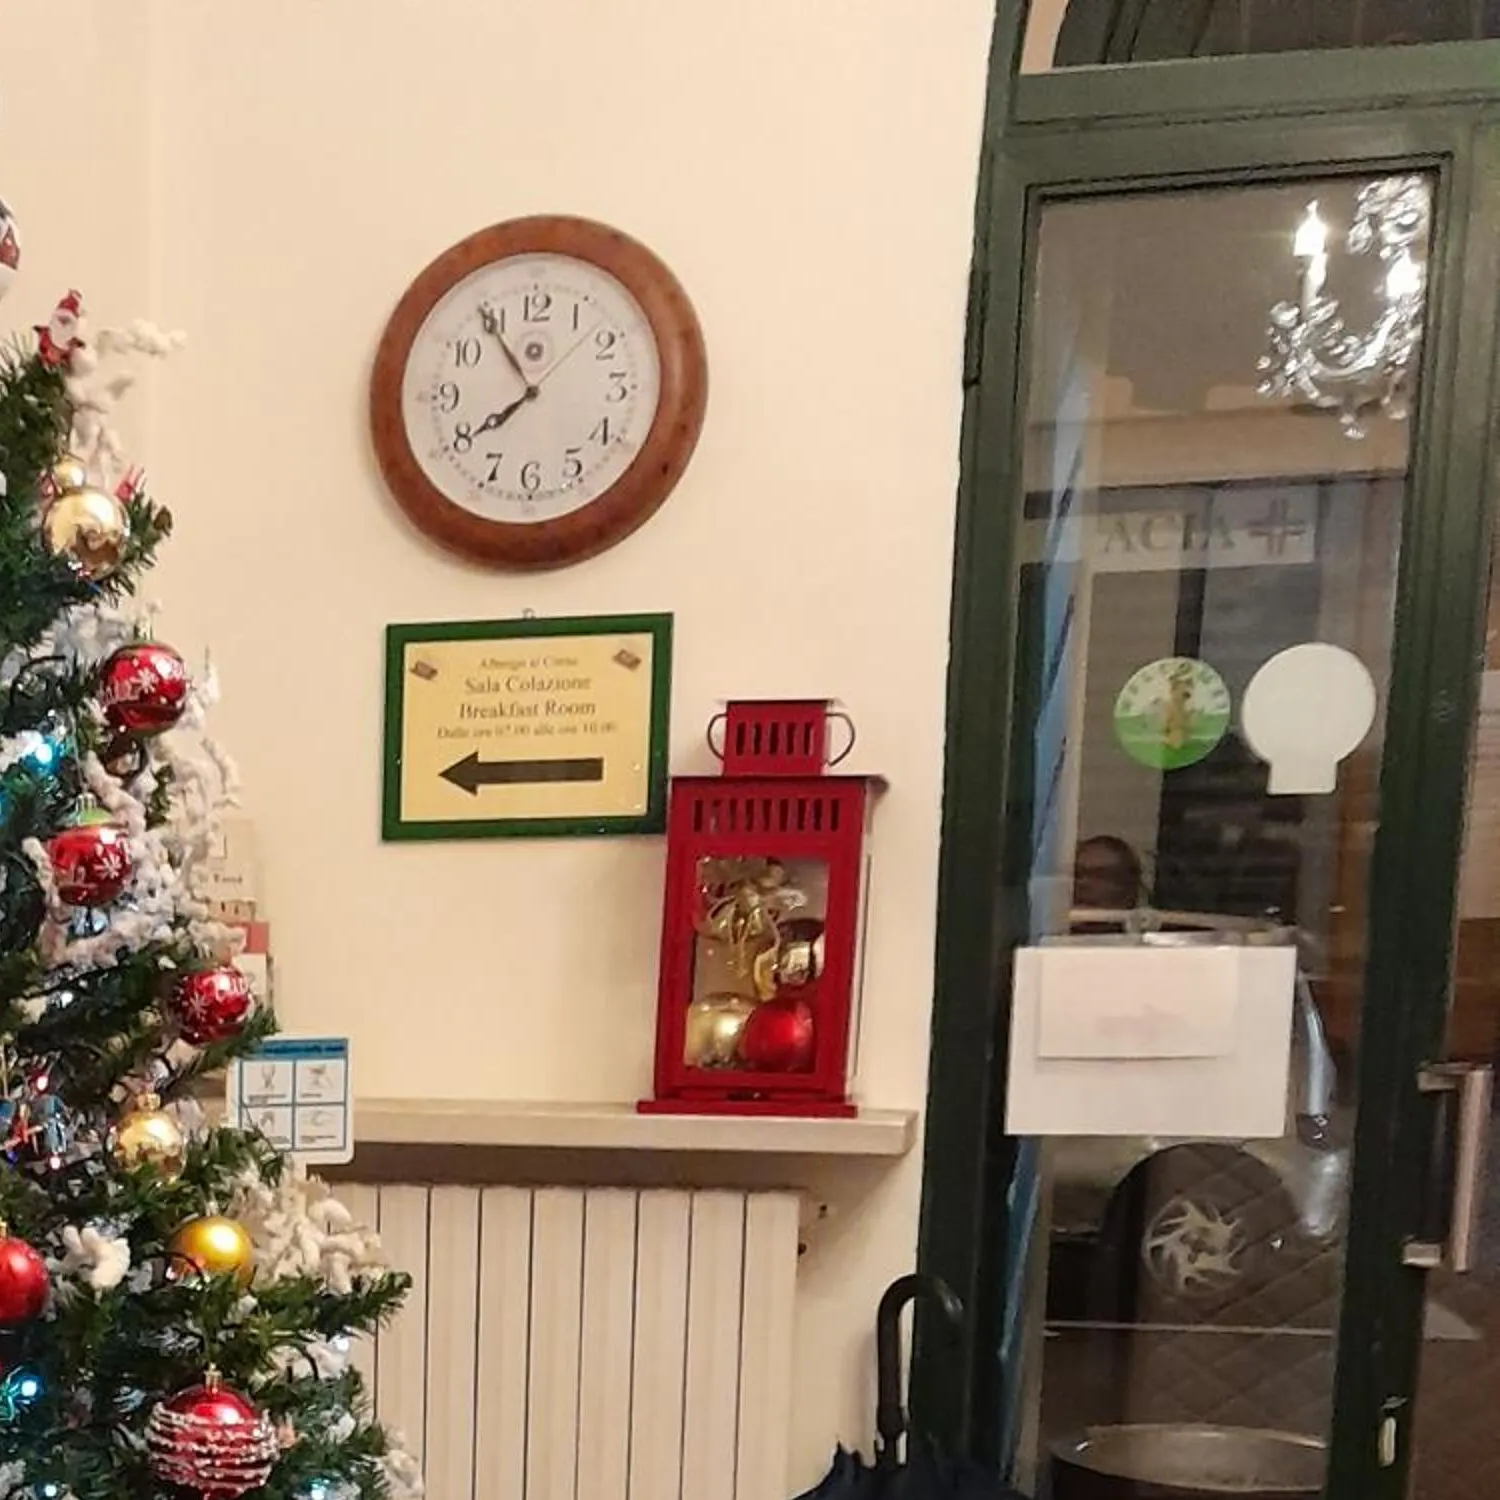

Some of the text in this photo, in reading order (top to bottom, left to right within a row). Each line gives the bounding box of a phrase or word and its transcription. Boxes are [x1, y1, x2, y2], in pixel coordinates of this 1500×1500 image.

[522, 294, 552, 322] 12
[454, 338, 482, 367] 10
[595, 331, 616, 360] 2
[438, 383, 460, 412] 9
[606, 372, 627, 402] 3
[452, 421, 473, 452] 8
[589, 416, 609, 446] 4
[485, 452, 503, 481] 7
[520, 461, 541, 492] 6
[563, 448, 583, 478] 5
[464, 674, 591, 695] Sala Colazione
[459, 699, 596, 719] Breakfast Room
